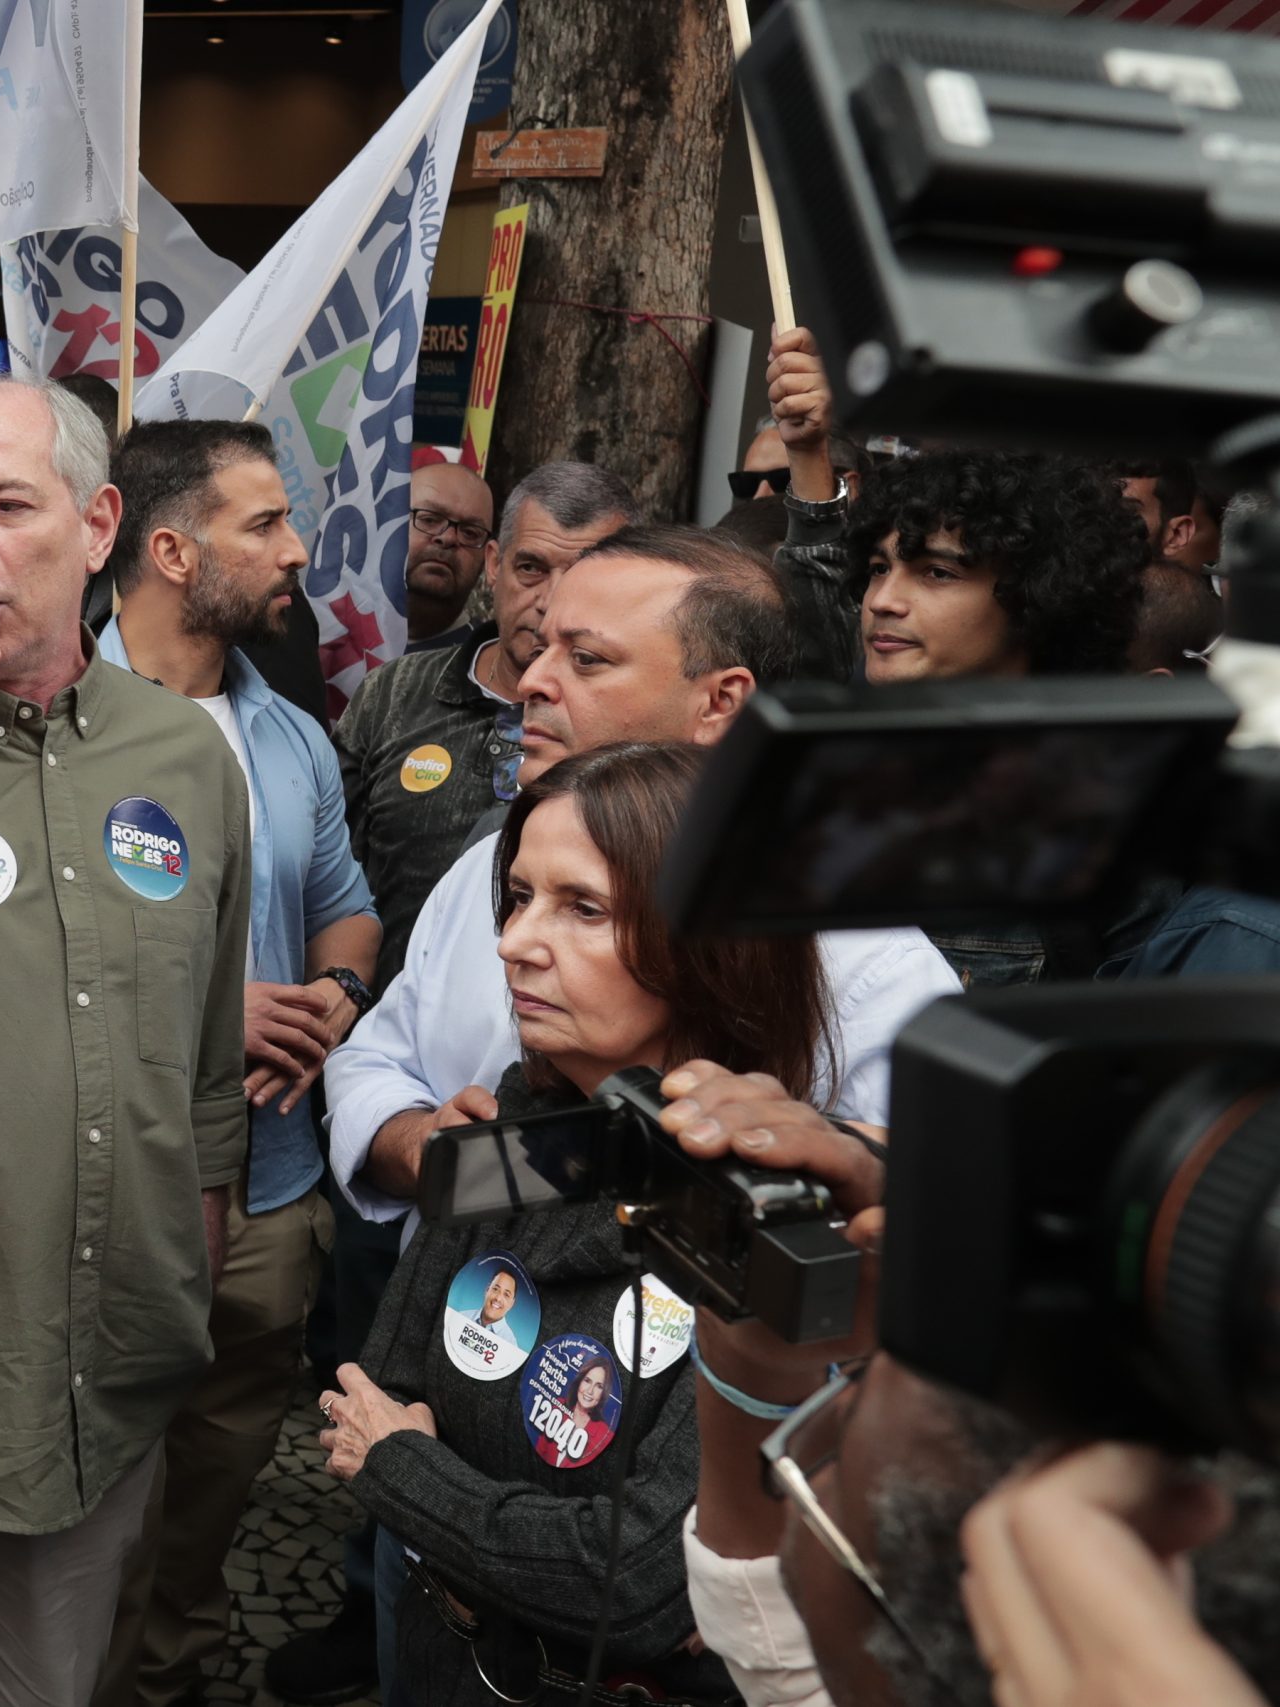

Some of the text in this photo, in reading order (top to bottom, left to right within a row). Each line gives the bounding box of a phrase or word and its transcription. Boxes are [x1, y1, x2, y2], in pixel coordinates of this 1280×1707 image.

[485, 220, 523, 294] PRO
[420, 324, 468, 352] ERTAS
[404, 757, 447, 772] Prefiro
[415, 768, 441, 781] Ciro
[111, 824, 180, 855] RODRIGO
[463, 1326, 498, 1352] RODRIGO
[483, 1350, 495, 1365] 12
[539, 1358, 568, 1385] Martha
[539, 1371, 562, 1395] Rocha
[529, 1394, 589, 1459] 12040
